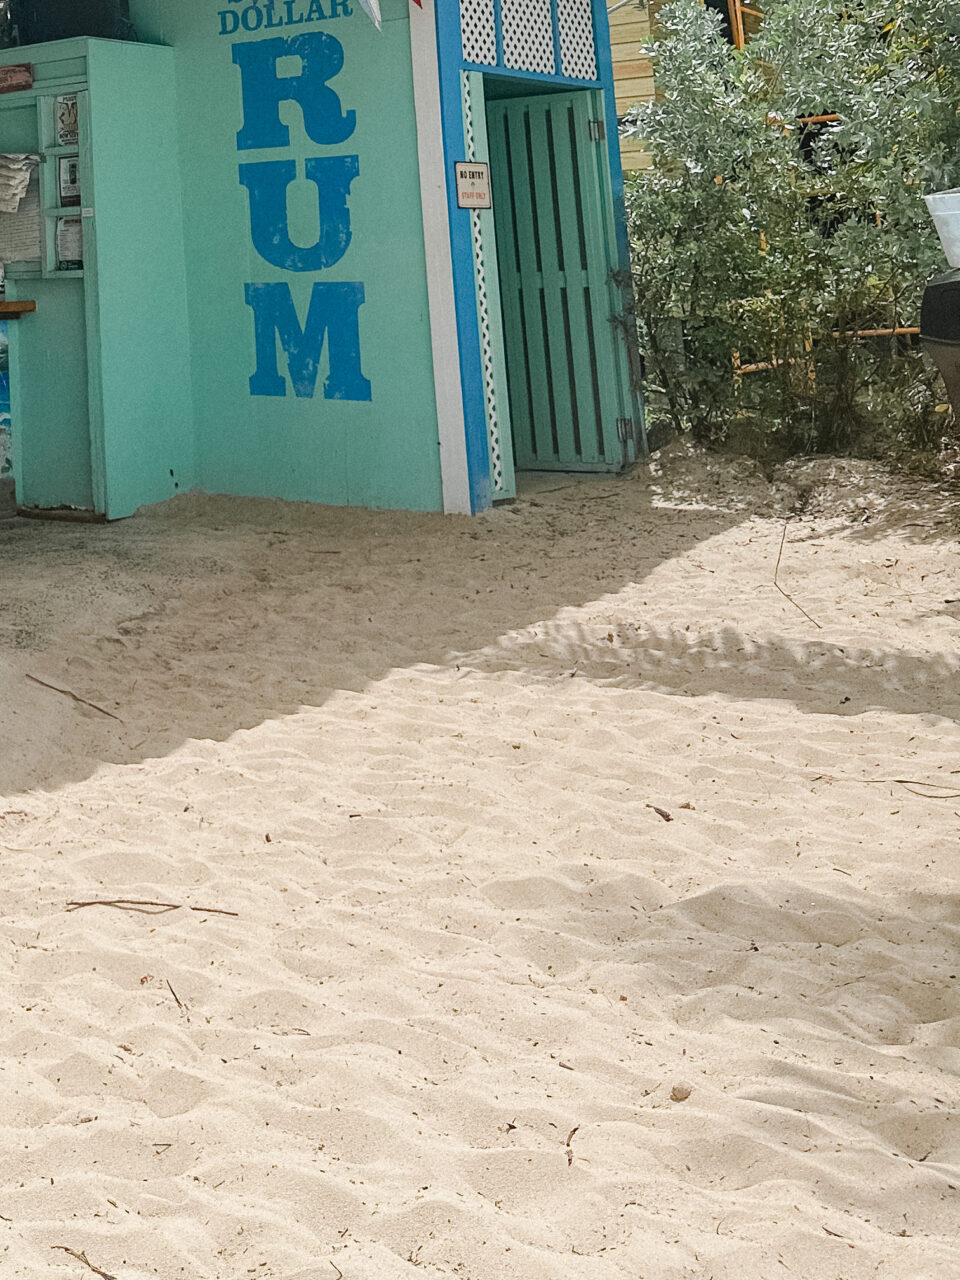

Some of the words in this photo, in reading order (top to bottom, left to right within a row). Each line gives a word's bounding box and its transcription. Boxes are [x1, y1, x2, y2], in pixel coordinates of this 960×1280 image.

[231, 30, 373, 403] RUM
[459, 170, 468, 179] NO
[468, 170, 484, 180] ENTRY
